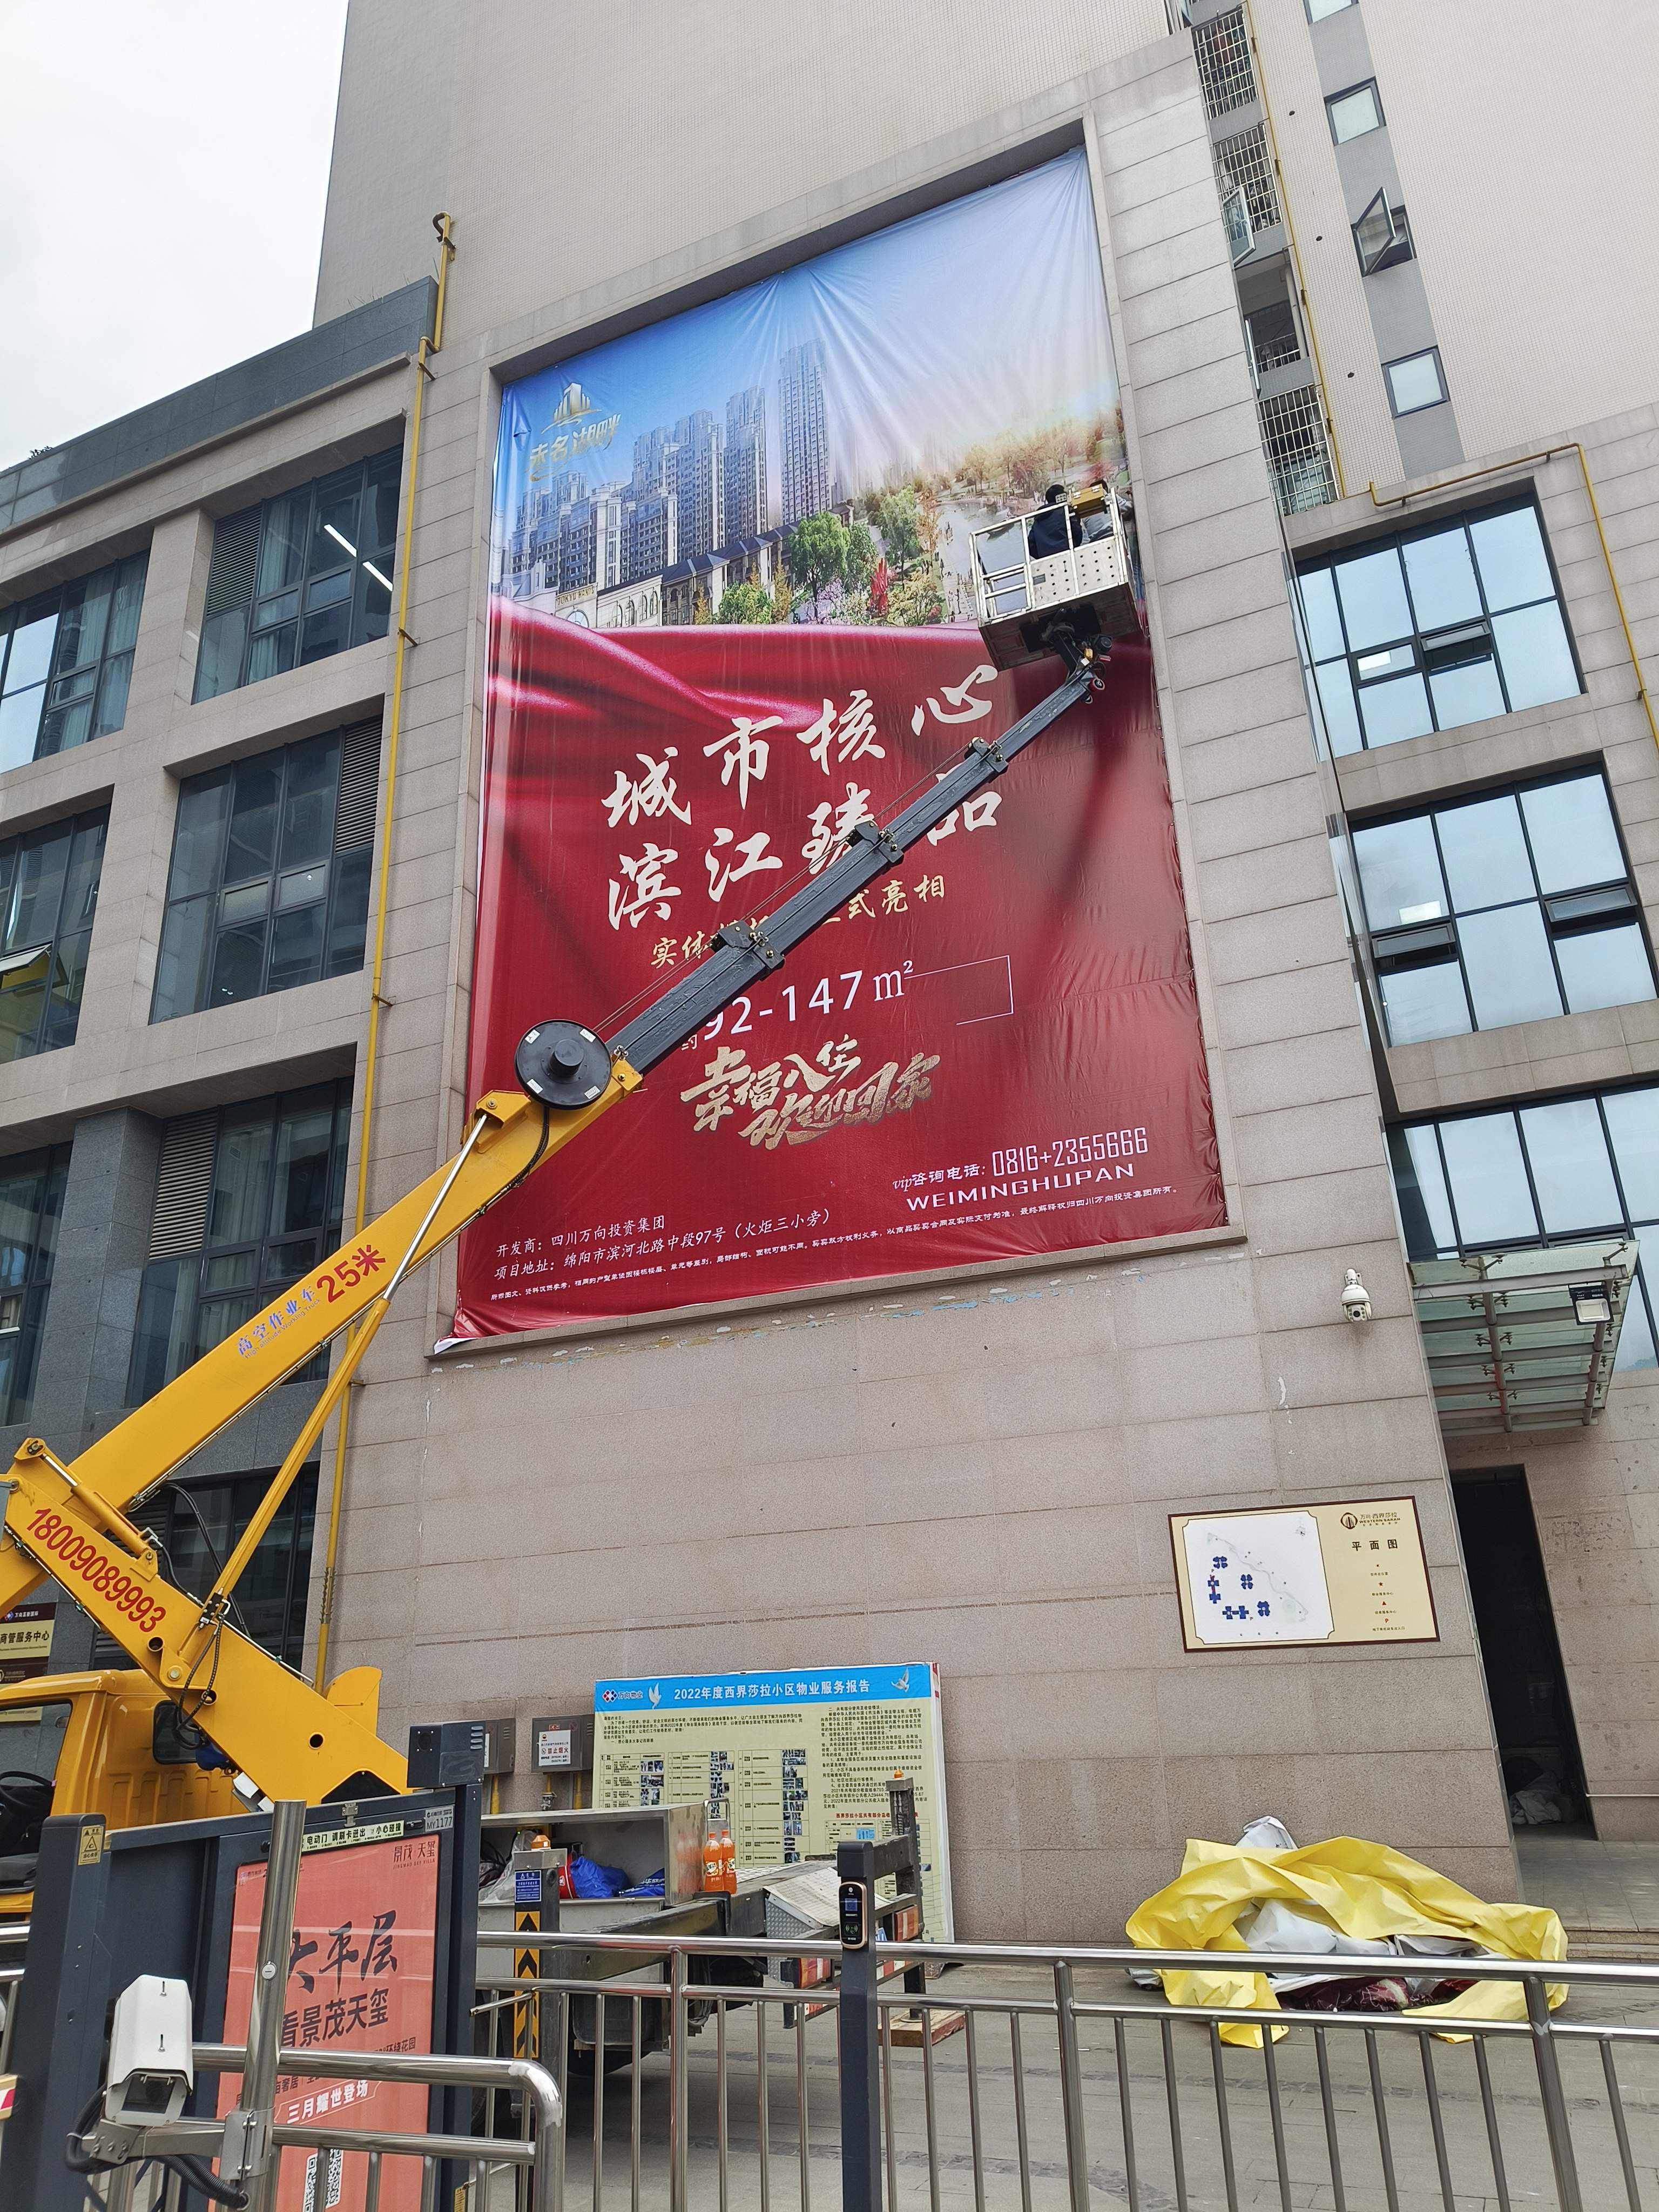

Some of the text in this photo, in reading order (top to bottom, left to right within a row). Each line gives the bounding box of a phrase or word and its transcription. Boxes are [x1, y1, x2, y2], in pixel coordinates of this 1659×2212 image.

[601, 664, 999, 828] 城市核心
[651, 874, 945, 969] 实体式亮相
[992, 1127, 1149, 1177] 0816+2355666
[906, 1163, 1135, 1211] WEIMINGHUPAN
[316, 1244, 386, 1303] 25米
[237, 1285, 315, 1356] 高空作业车
[280, 1310, 306, 1331] Working
[26, 1507, 166, 1633] 18009089993
[1352, 1539, 1398, 1552] 平面图
[673, 1680, 871, 1701] 2022年度西界莎拉小区物业服务报告
[427, 1816, 453, 1830] MY1177
[287, 2079, 369, 2124] 三月耀世登场
